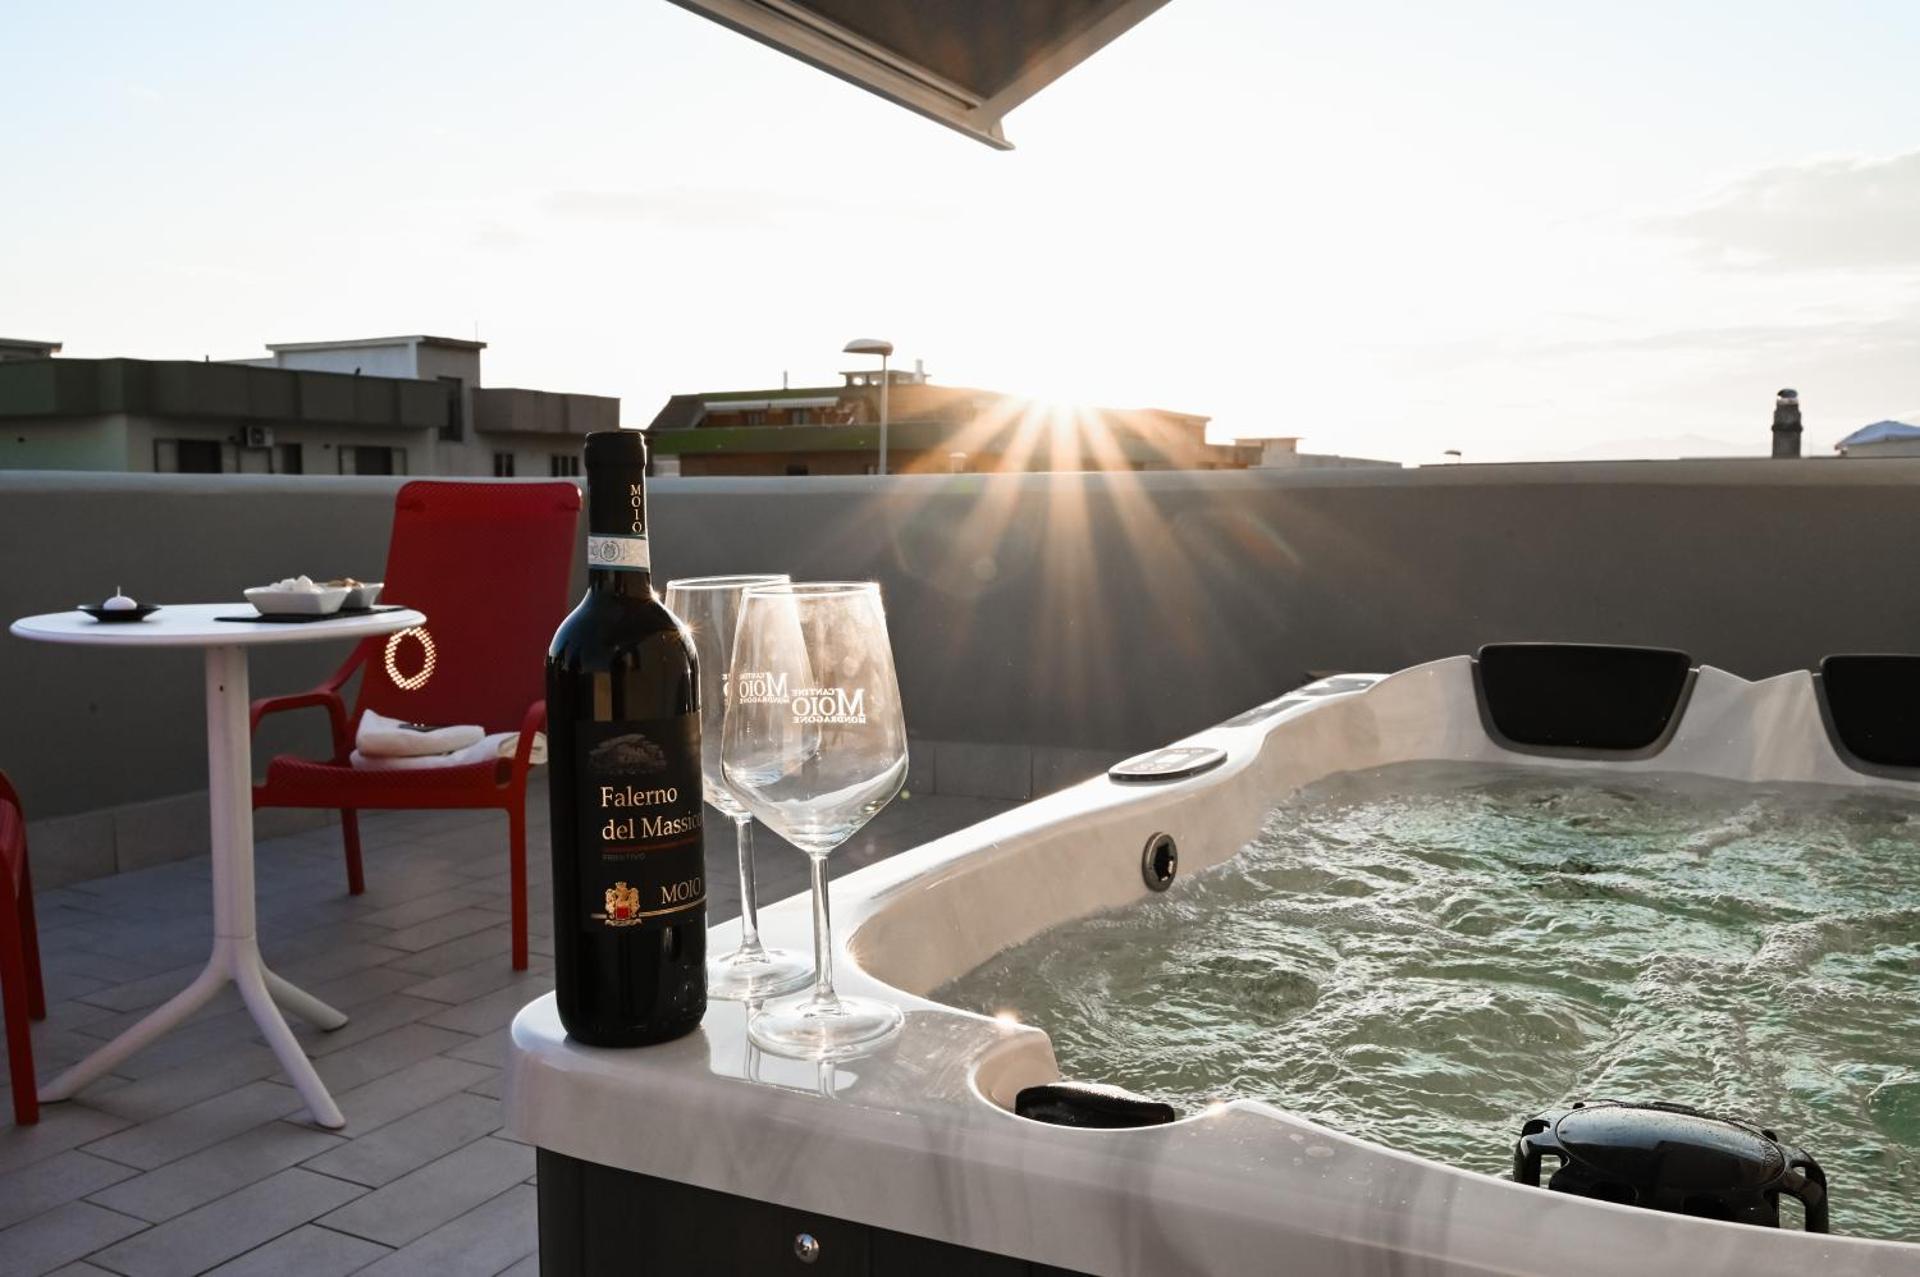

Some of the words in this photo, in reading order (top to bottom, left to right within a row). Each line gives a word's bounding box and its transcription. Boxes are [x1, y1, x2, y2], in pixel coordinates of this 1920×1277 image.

[630, 484, 642, 533] MOIO
[600, 786, 678, 808] Falerno
[602, 819, 634, 841] del
[660, 876, 702, 904] MOIO
